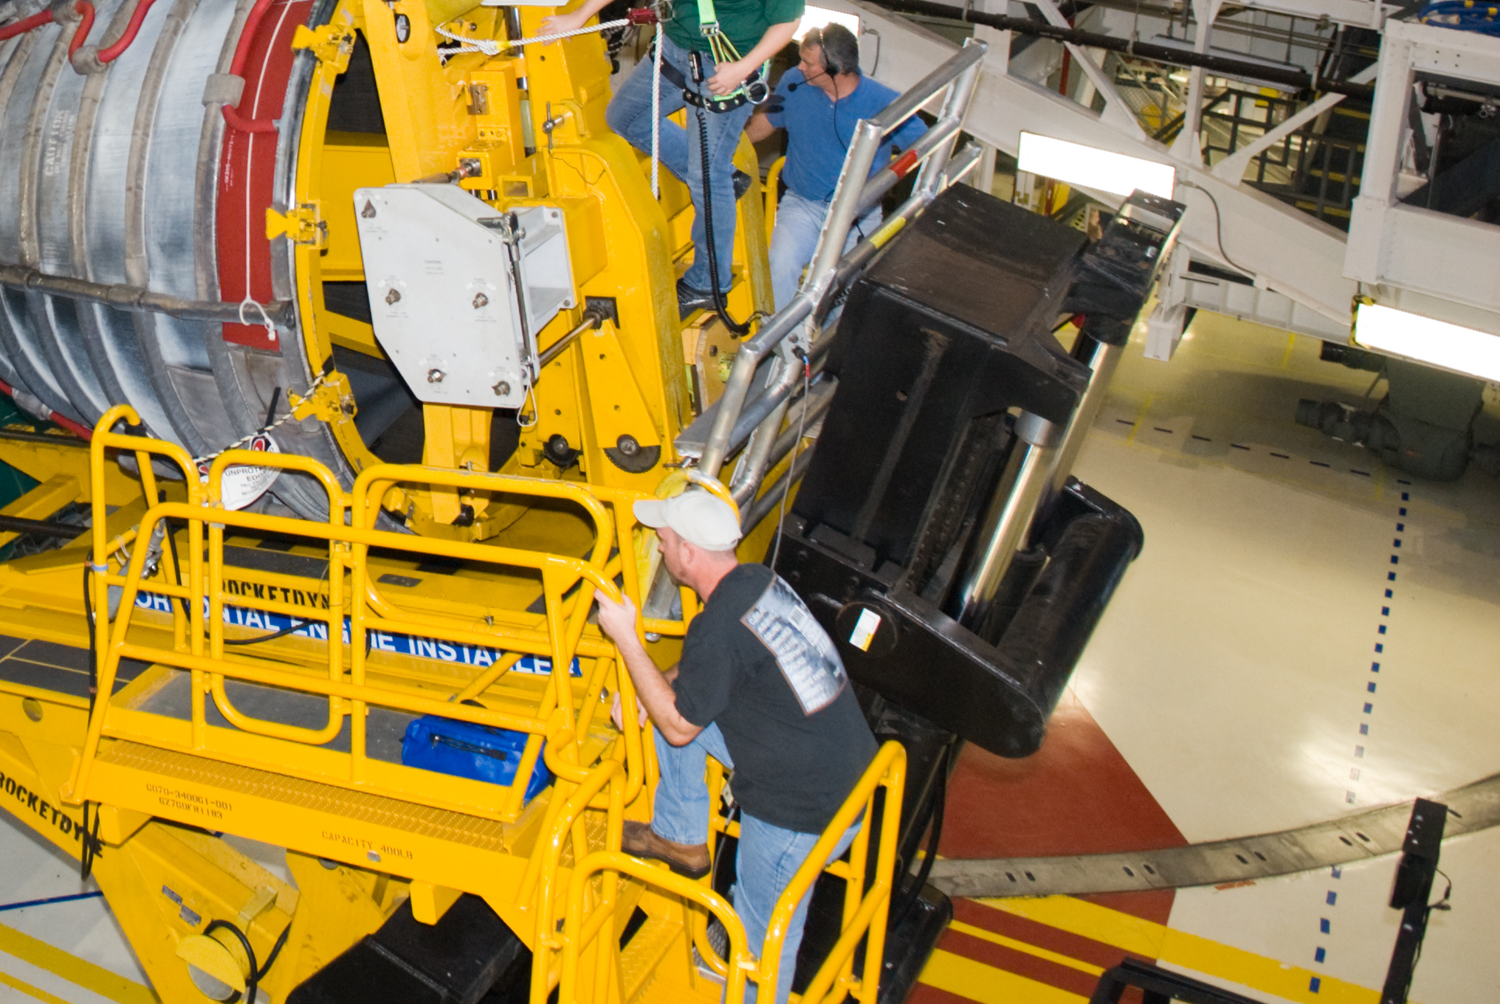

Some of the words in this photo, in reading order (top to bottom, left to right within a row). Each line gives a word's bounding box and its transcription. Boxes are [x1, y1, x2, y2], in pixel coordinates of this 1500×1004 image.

[221, 579, 330, 610] OCKETDYN
[407, 634, 582, 677] INSTALE
[322, 830, 373, 850] CAPACITY
